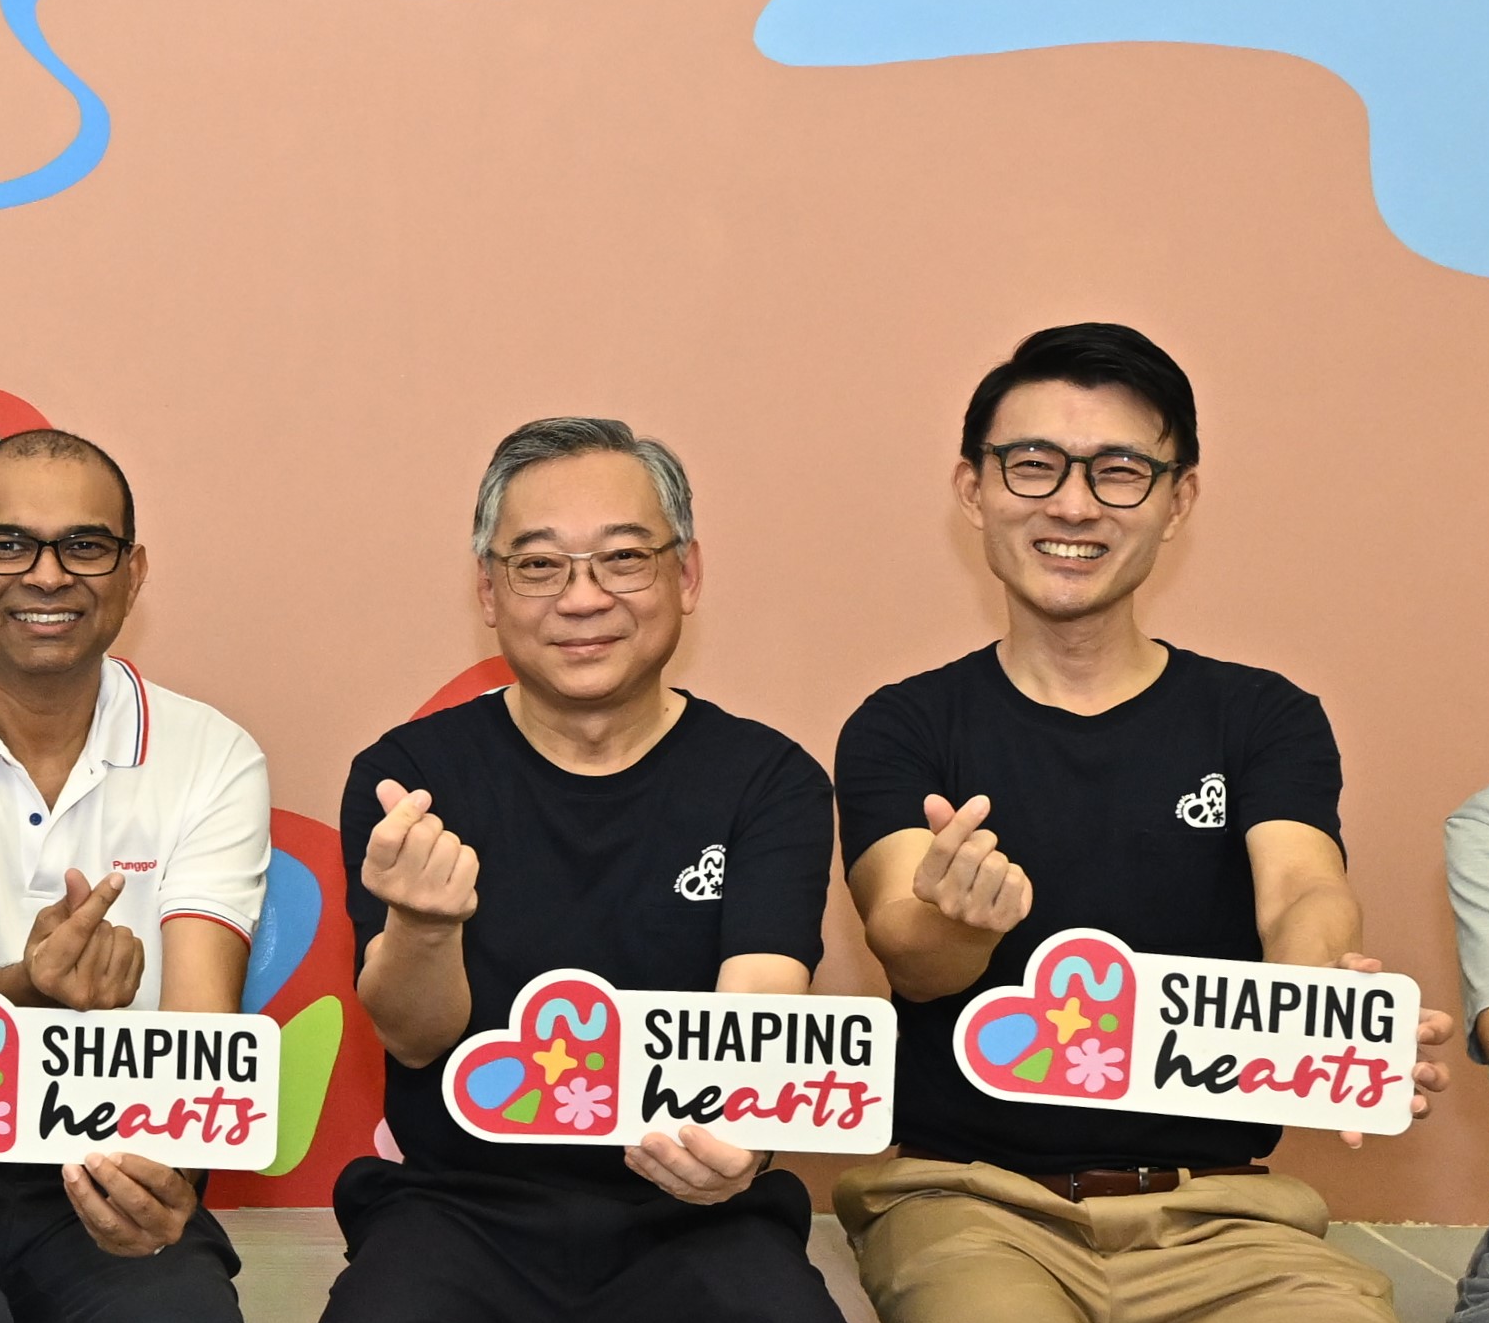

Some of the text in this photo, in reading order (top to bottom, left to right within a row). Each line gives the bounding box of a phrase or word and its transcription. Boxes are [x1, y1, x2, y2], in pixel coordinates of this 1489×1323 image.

[112, 859, 158, 872] Punggol
[644, 1008, 873, 1067] SHAPING
[1159, 972, 1395, 1044] SHAPING
[41, 1024, 258, 1083] SHAPING
[1154, 1029, 1403, 1109] hearts
[38, 1080, 267, 1146] hearts
[641, 1063, 882, 1130] hearts
